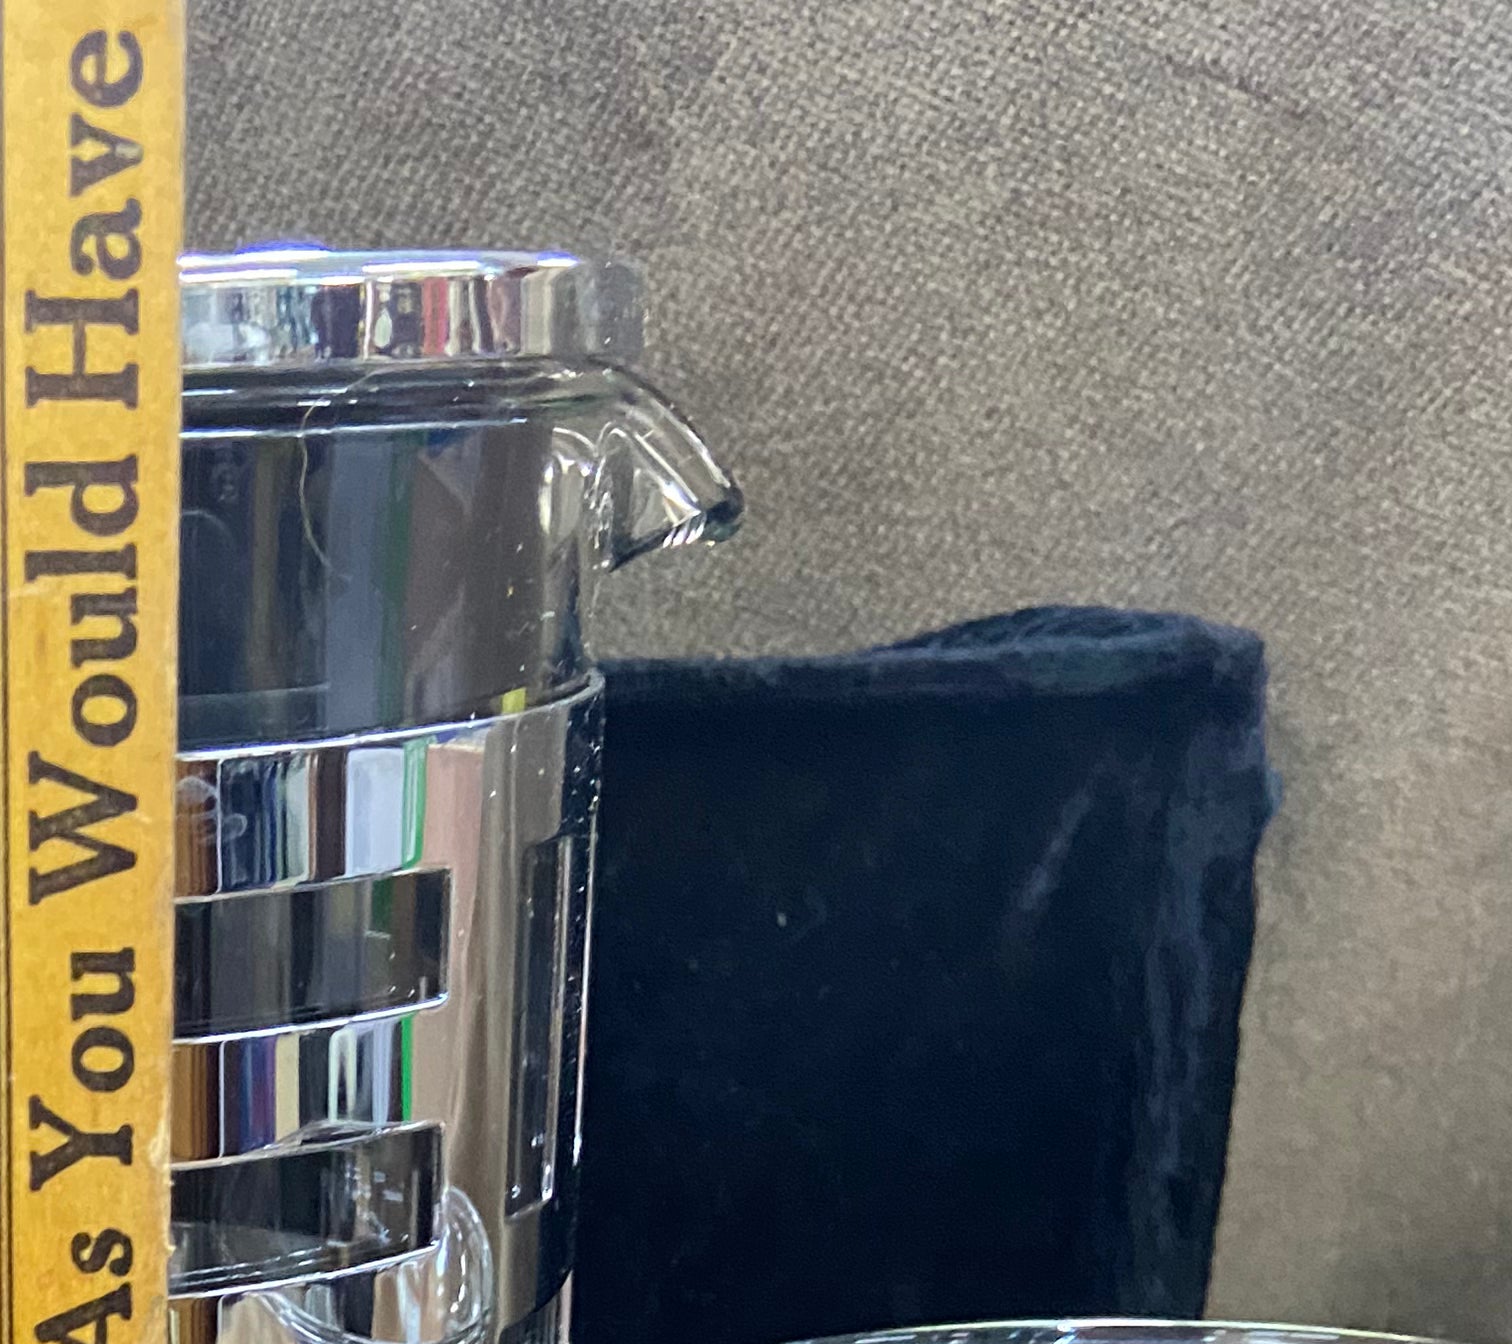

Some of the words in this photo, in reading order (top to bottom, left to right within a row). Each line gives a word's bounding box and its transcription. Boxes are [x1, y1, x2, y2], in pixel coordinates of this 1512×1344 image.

[24, 29, 144, 409] Have
[23, 453, 139, 906] Would
[29, 945, 136, 1193] You
